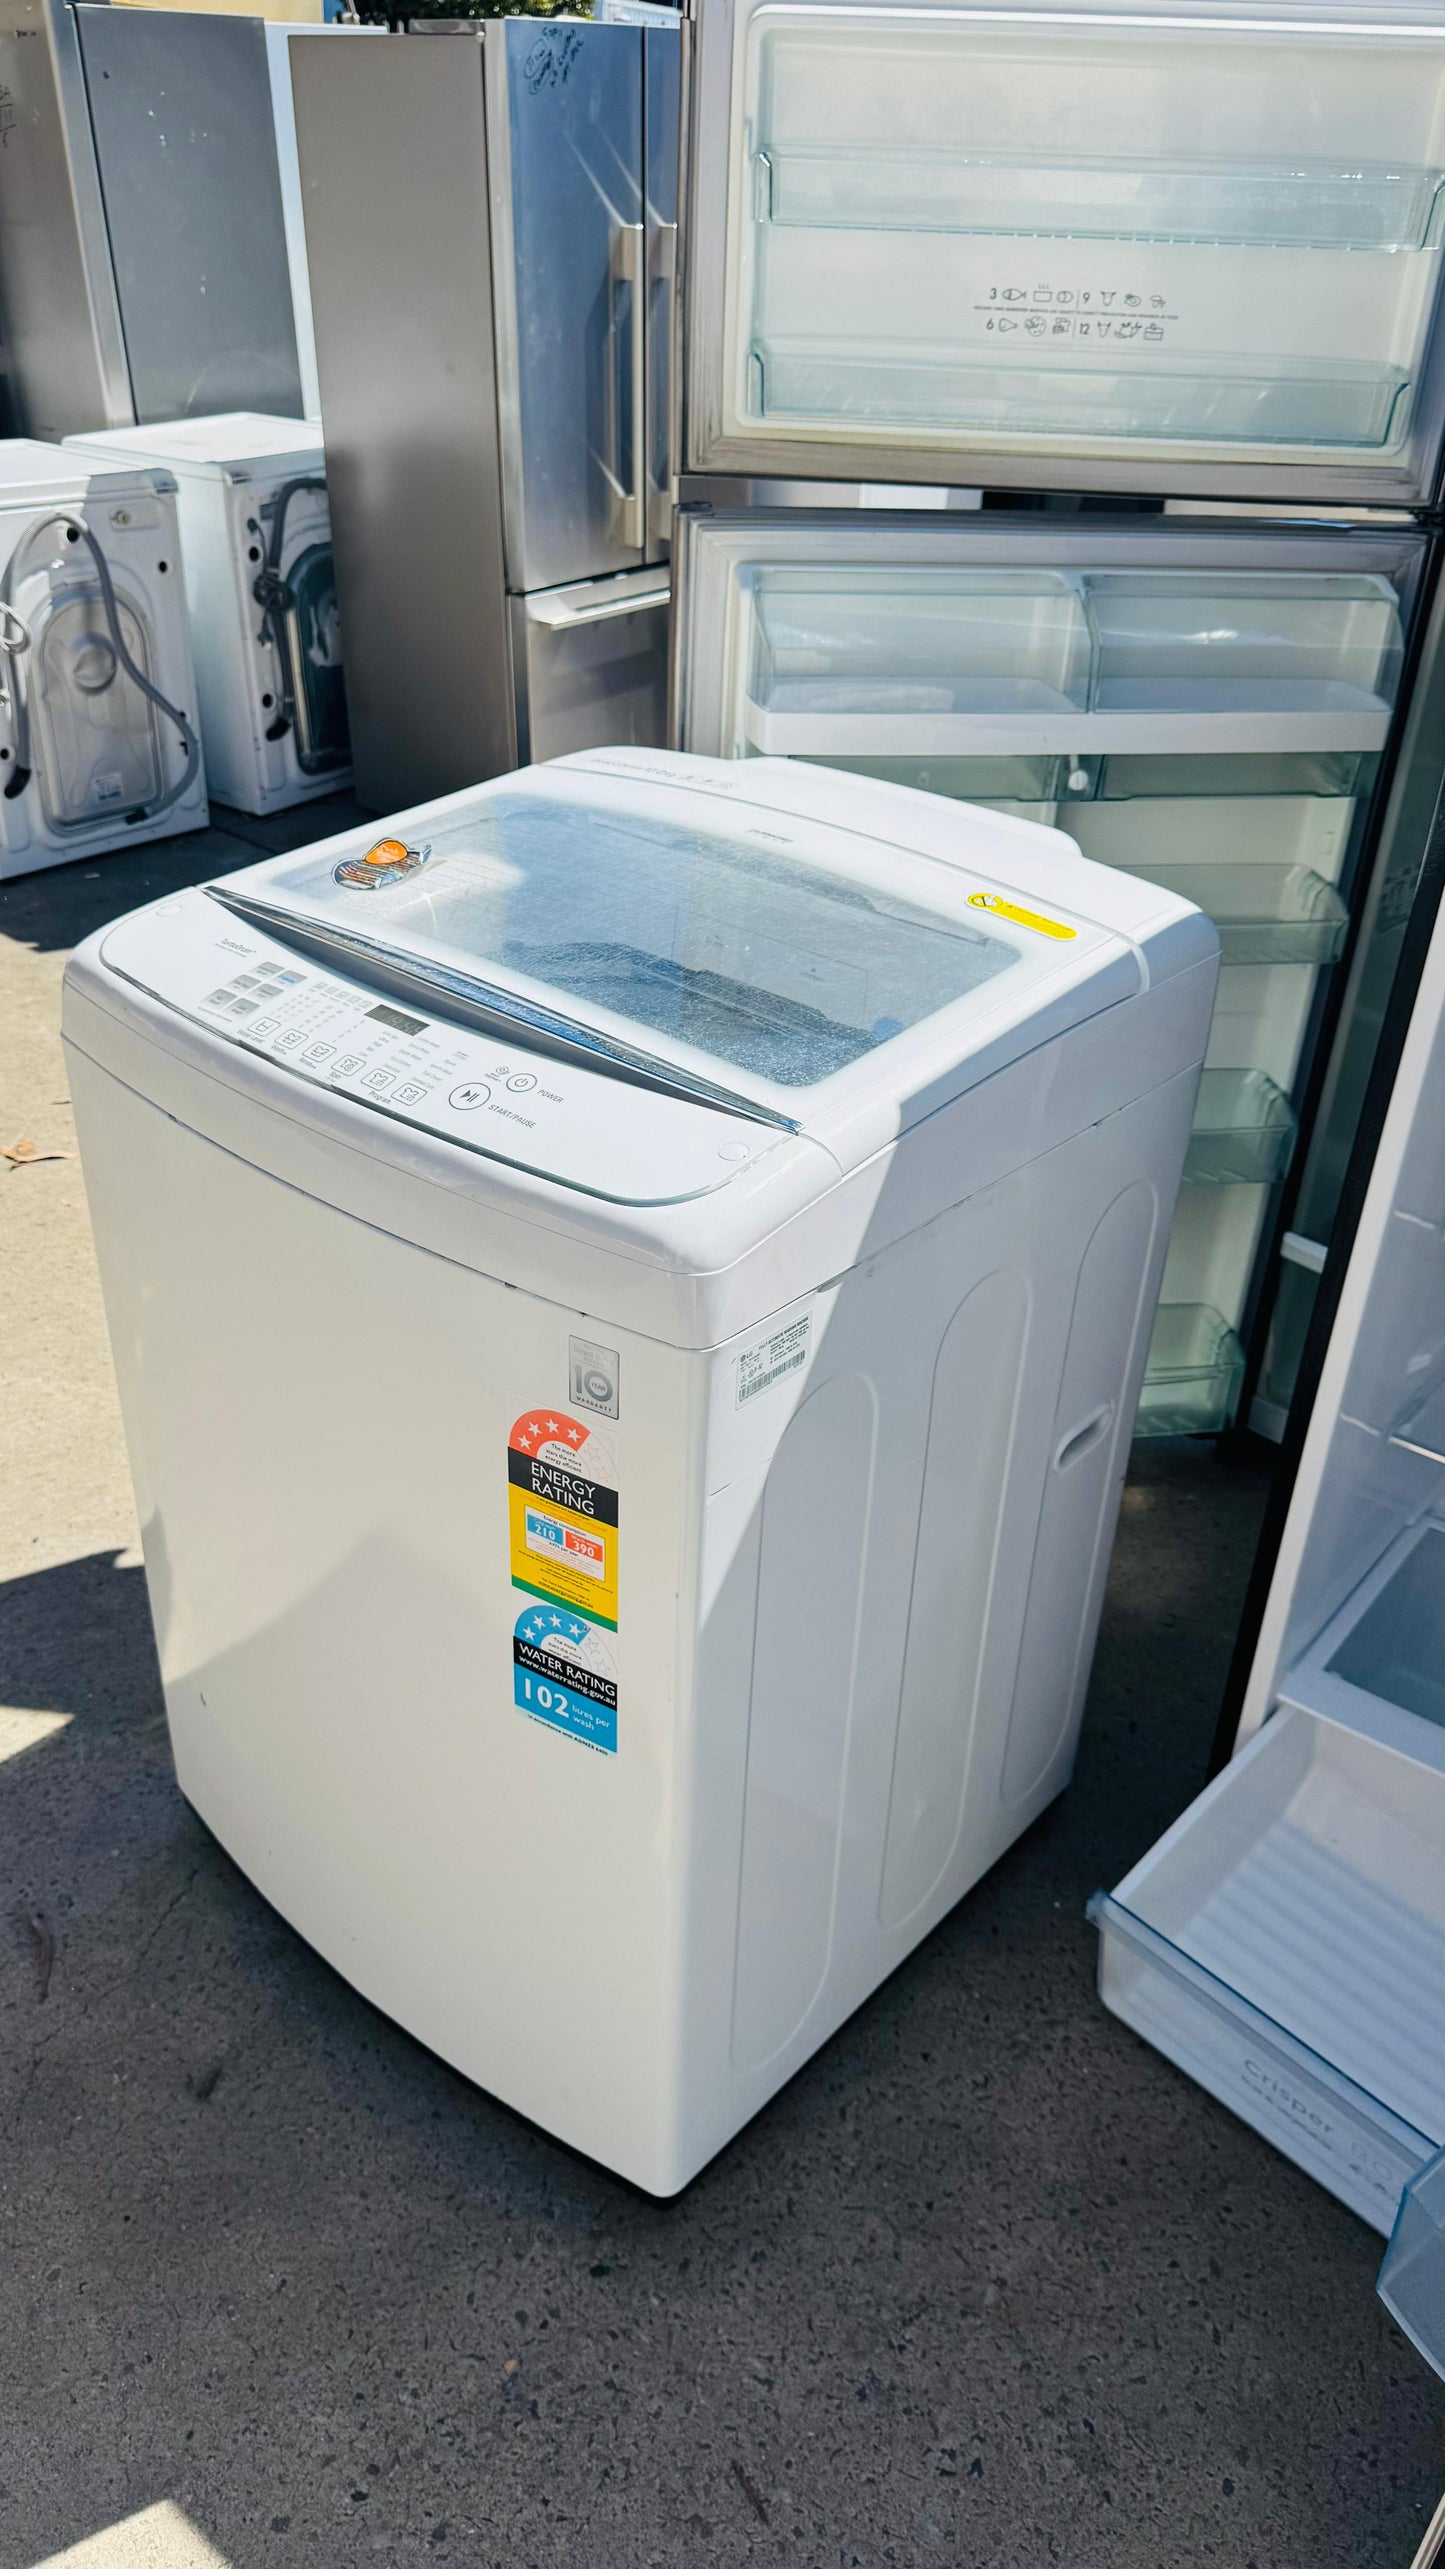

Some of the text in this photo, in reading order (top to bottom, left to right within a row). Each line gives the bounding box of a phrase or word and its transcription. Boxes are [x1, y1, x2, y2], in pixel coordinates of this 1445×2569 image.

[989, 288, 1091, 304] 3 9
[986, 318, 1090, 335] 6 12
[368, 1090, 392, 1105] Program
[538, 1089, 565, 1103] POWER
[488, 1103, 537, 1129] START/PAUSE
[574, 1364, 613, 1402] 10
[591, 1382, 607, 1392] YEAR
[576, 1395, 612, 1412] WARRANTY
[546, 1448, 582, 1467] stars the more
[551, 1443, 576, 1458] The more
[545, 1455, 561, 1465] energy
[531, 1461, 596, 1499] ENERGY
[532, 1477, 595, 1515] RATING
[543, 1514, 558, 1526] Energy
[534, 1523, 556, 1540] 210
[573, 1540, 595, 1557] 390
[563, 1641, 577, 1651] more
[519, 1642, 616, 1697] WATER RATING
[519, 1655, 616, 1706] www.waterrating.gov.au
[524, 1677, 610, 1728] 102 litres per
[573, 1716, 595, 1730] wash
[1243, 2058, 1335, 2133] Crisper
